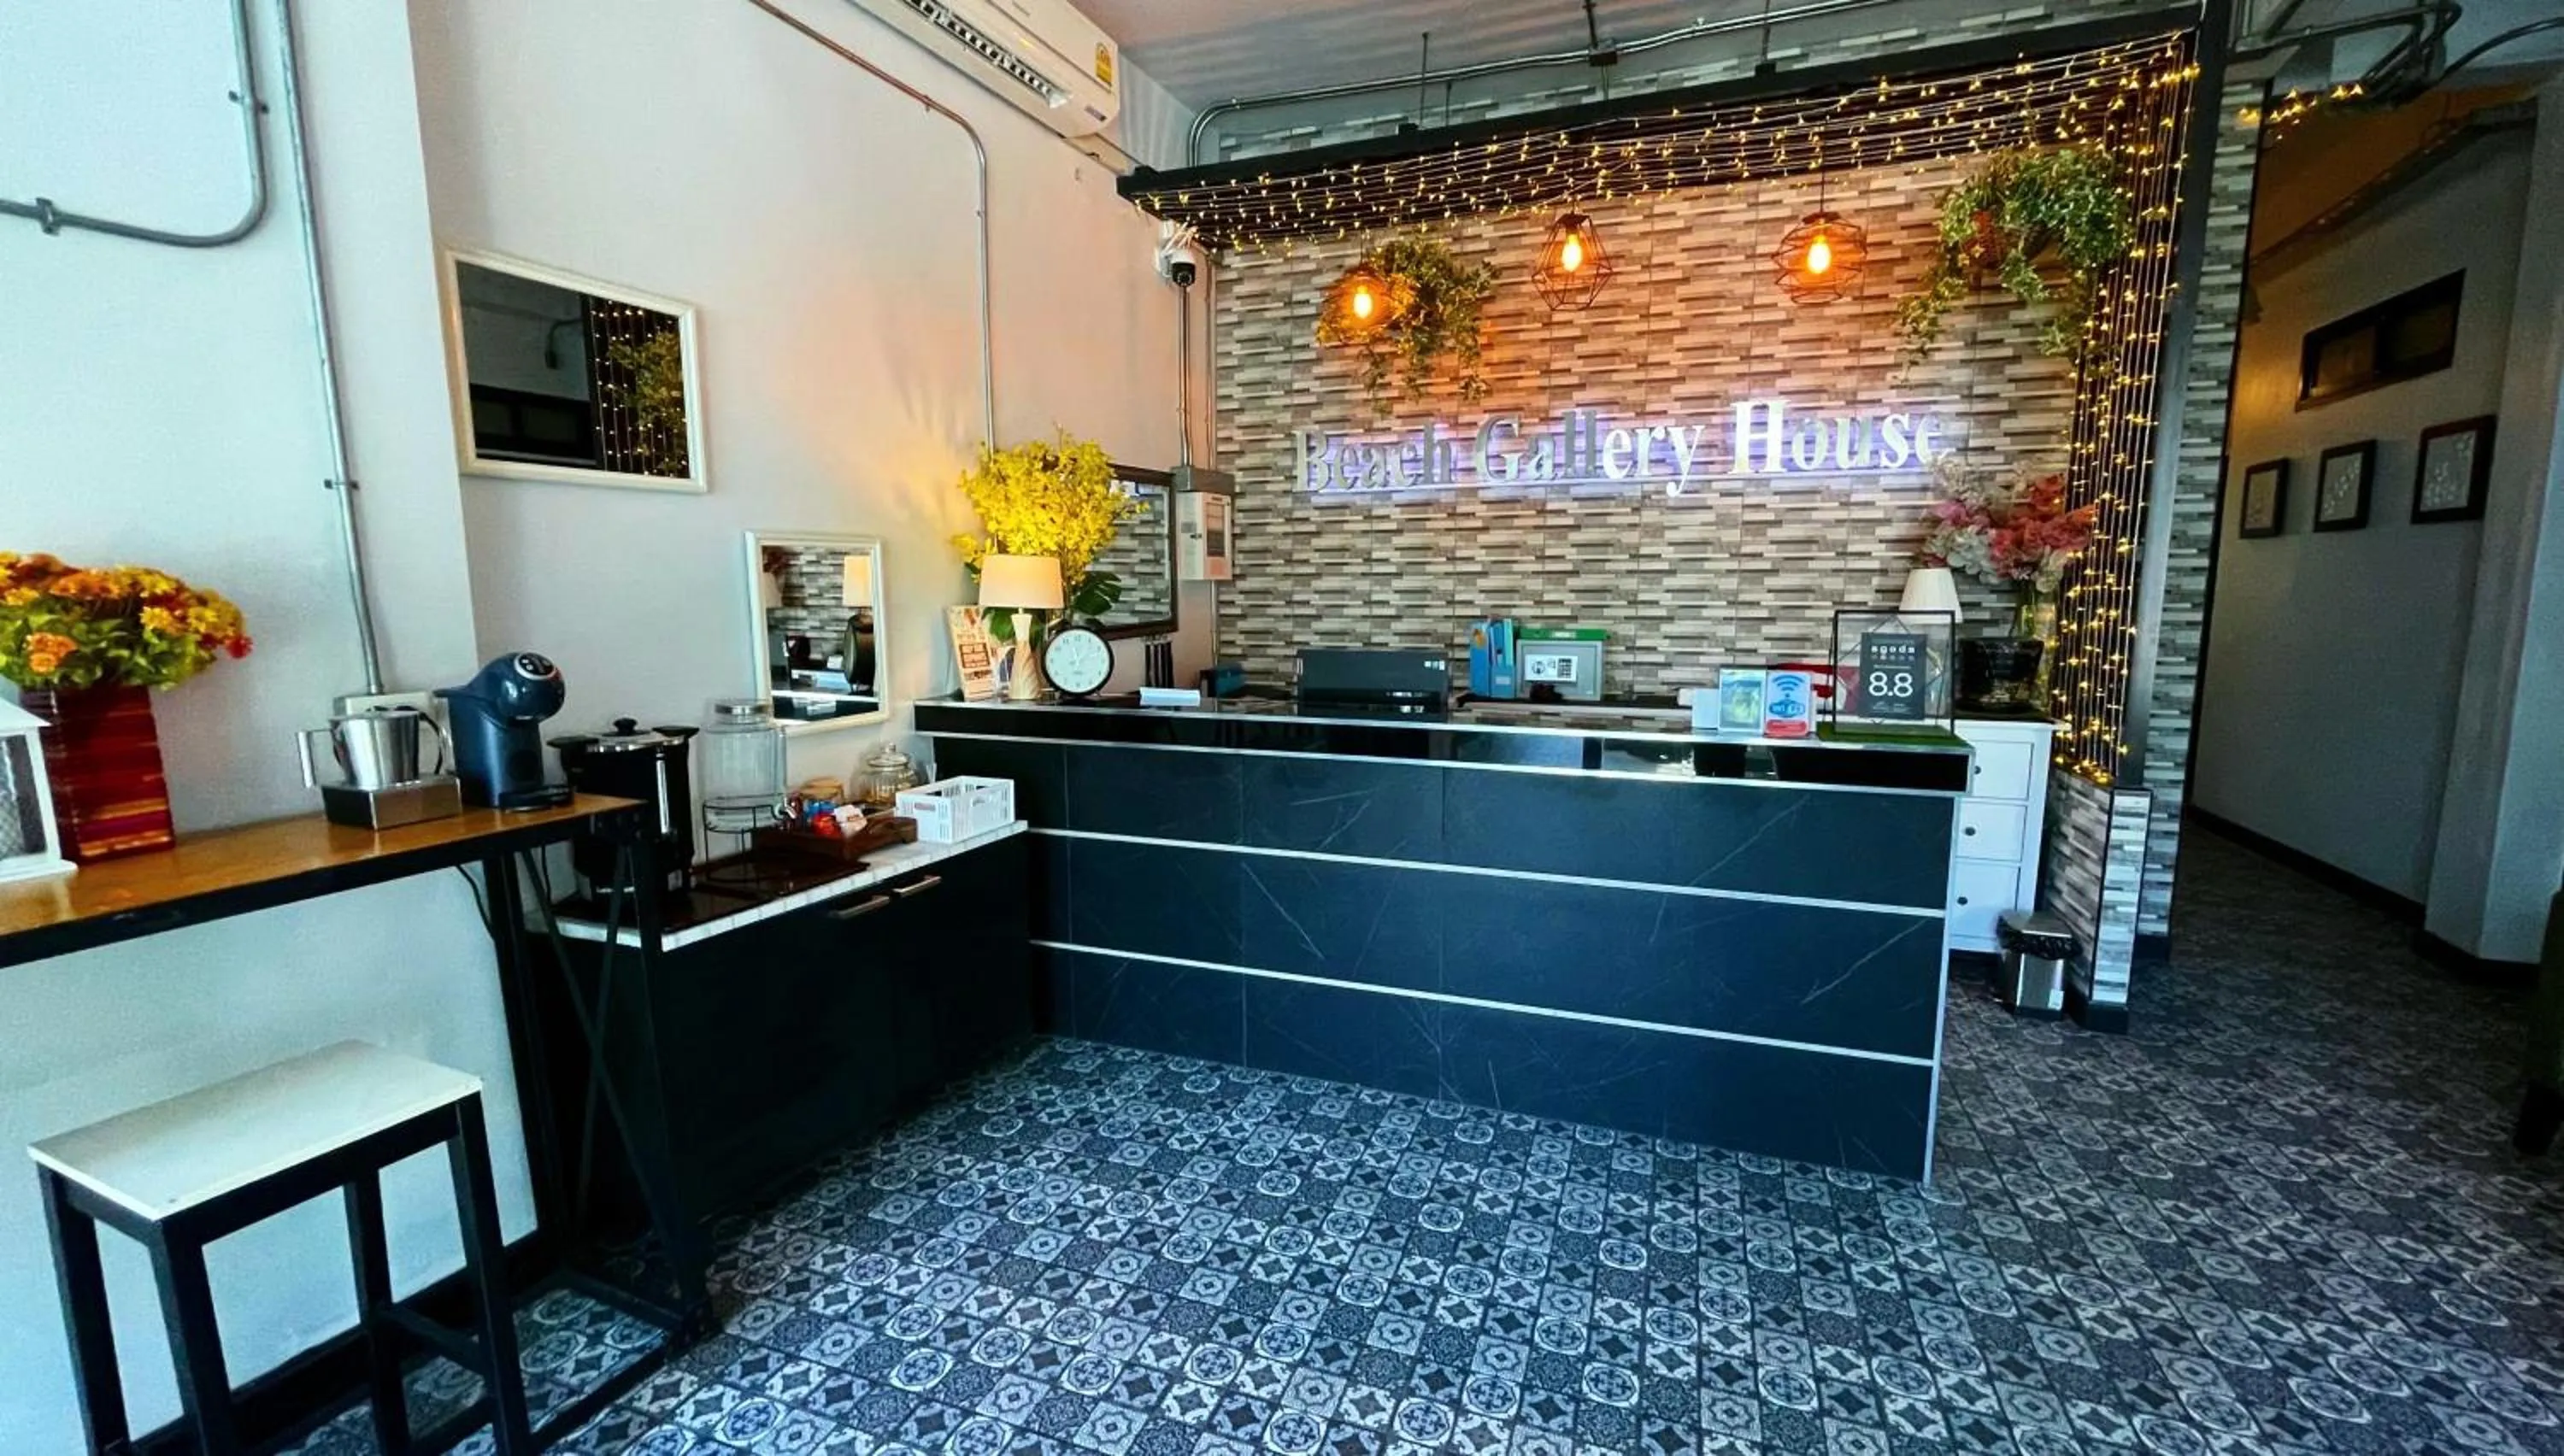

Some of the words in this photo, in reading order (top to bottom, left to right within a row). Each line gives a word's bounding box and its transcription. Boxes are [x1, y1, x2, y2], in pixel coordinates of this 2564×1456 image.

[1291, 421, 1455, 491] Beach
[1474, 410, 1706, 496] Gallery
[1726, 397, 1956, 475] House
[1868, 672, 1914, 698] 8.8
